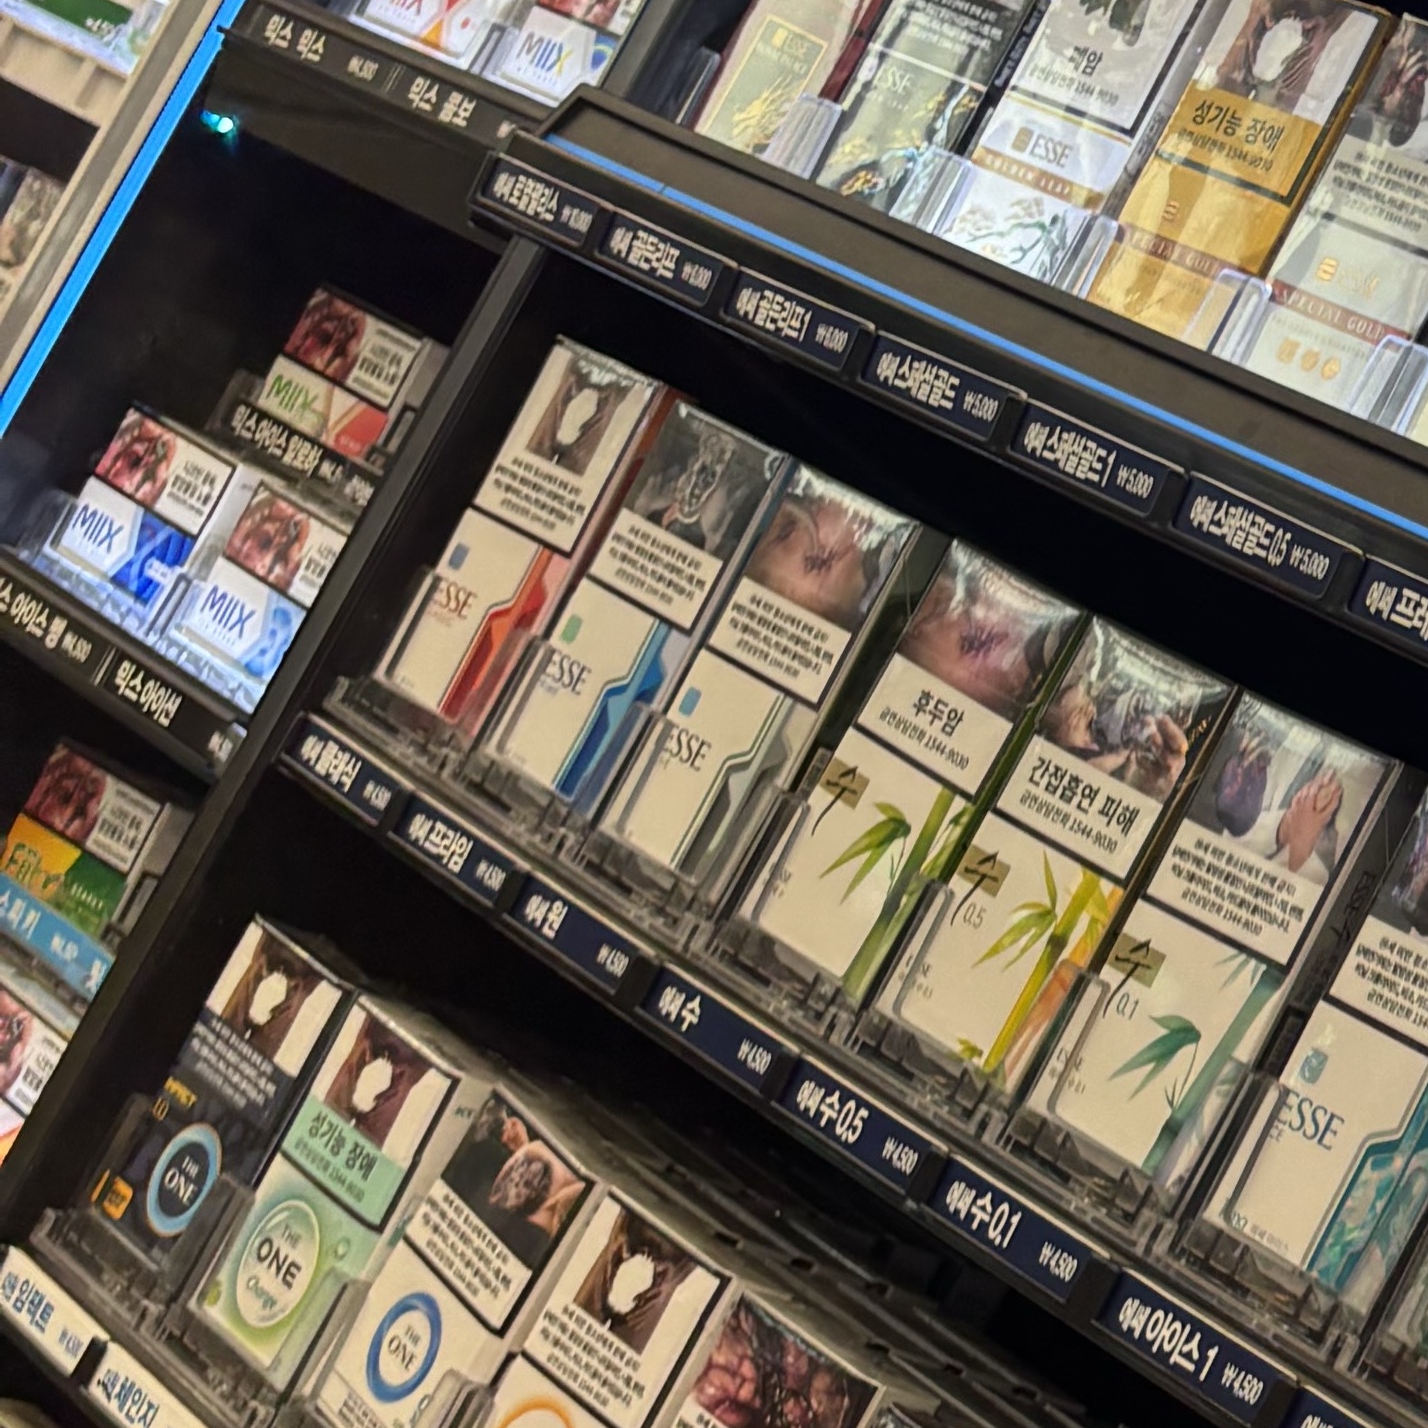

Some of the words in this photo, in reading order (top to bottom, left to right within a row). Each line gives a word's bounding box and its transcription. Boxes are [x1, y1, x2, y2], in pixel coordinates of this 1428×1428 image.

[1193, 97, 1245, 138] 성기능
[1244, 117, 1285, 152] 장애
[201, 584, 258, 640] MIIX
[911, 688, 966, 736] 후두암
